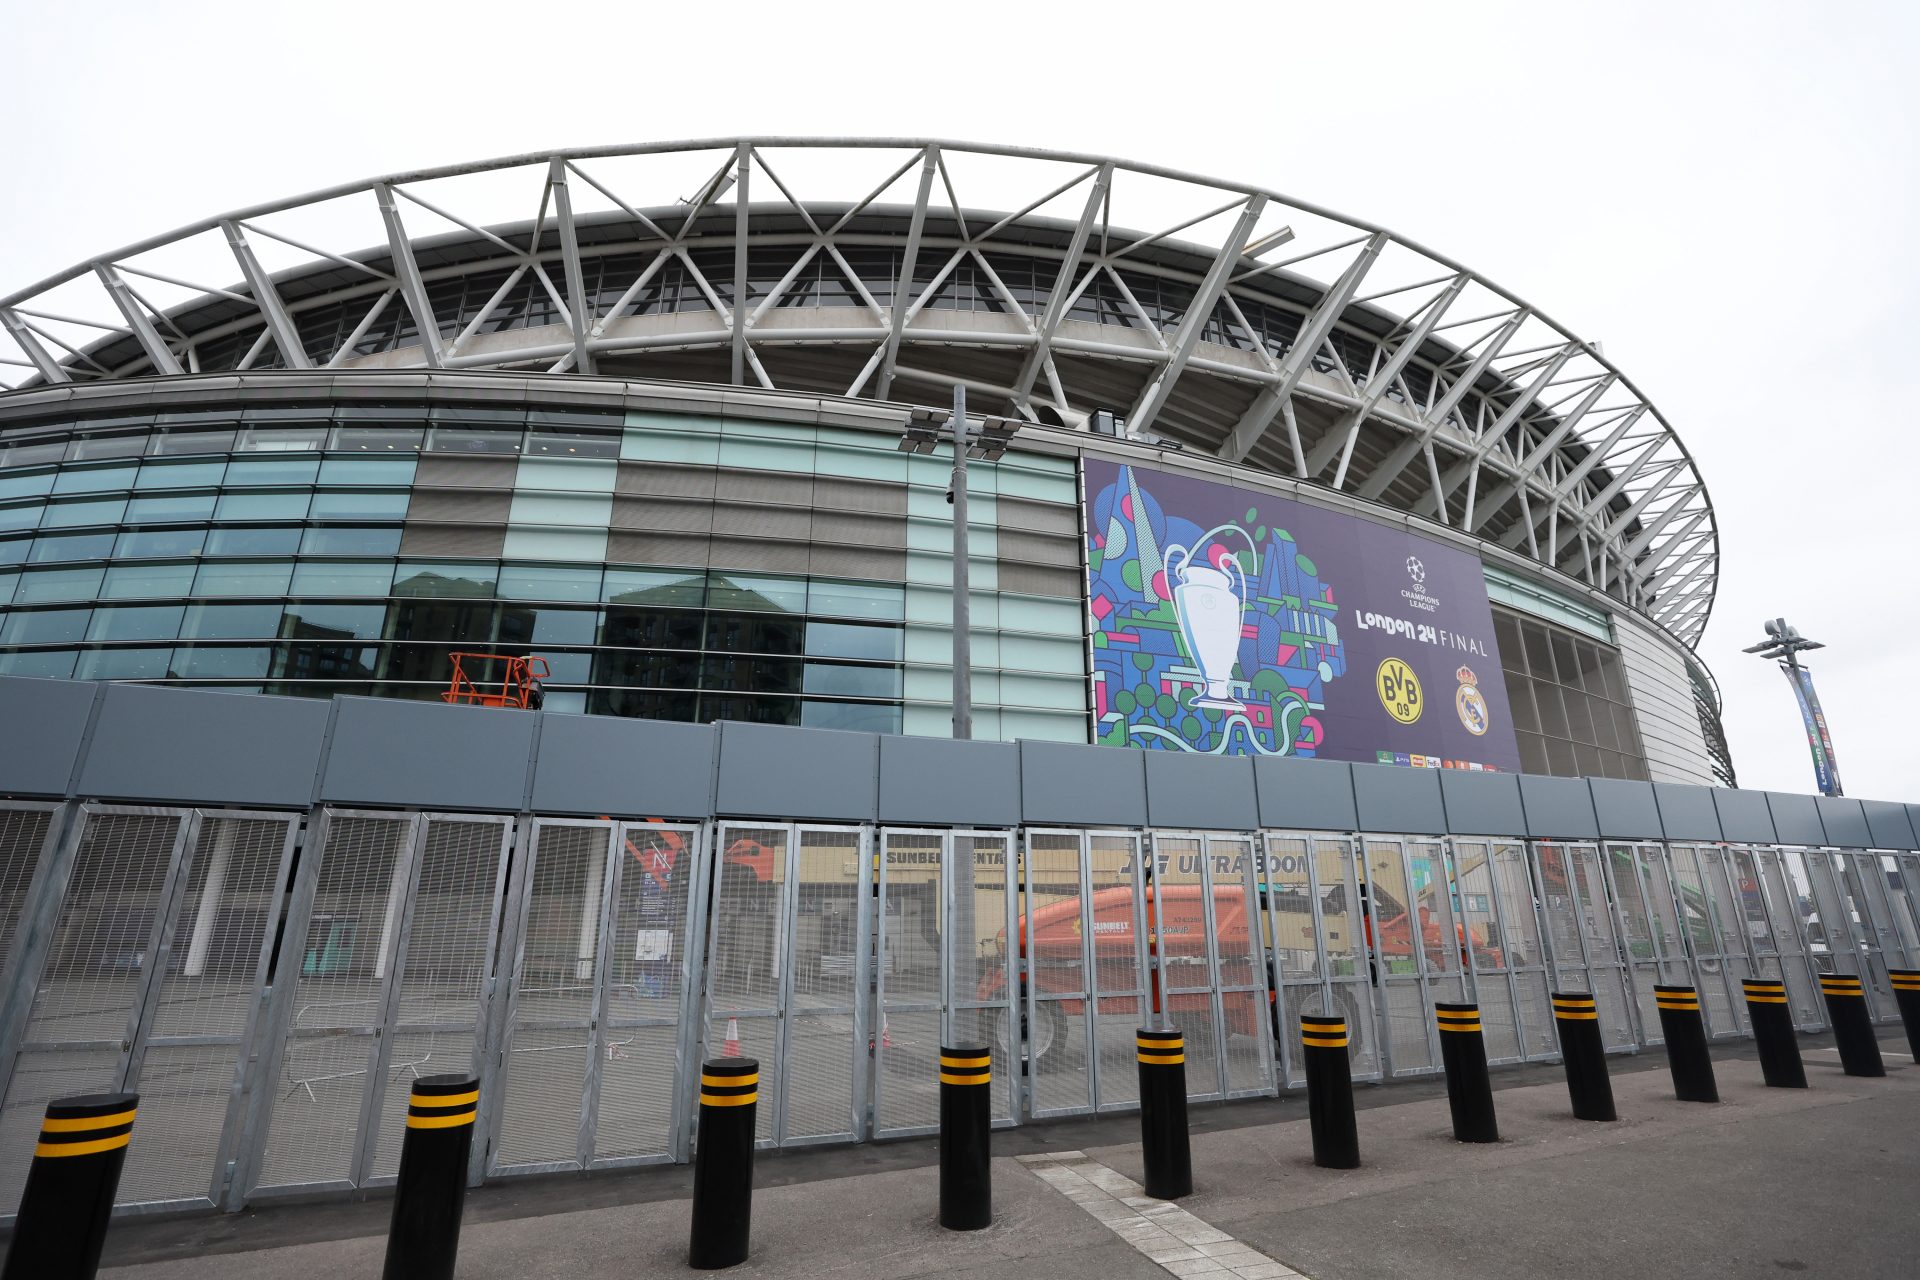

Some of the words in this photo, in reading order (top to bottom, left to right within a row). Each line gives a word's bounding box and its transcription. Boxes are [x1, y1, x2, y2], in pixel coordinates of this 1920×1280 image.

[1401, 589, 1440, 606] CHAMPIONS
[1409, 599, 1436, 613] LEAGUE
[1417, 624, 1438, 645] 24
[1440, 629, 1488, 657] FINAL
[1382, 664, 1418, 705] BVB
[1397, 702, 1410, 717] 09
[887, 852, 941, 864] SUNBE
[1150, 927, 1189, 935] 150AJP
